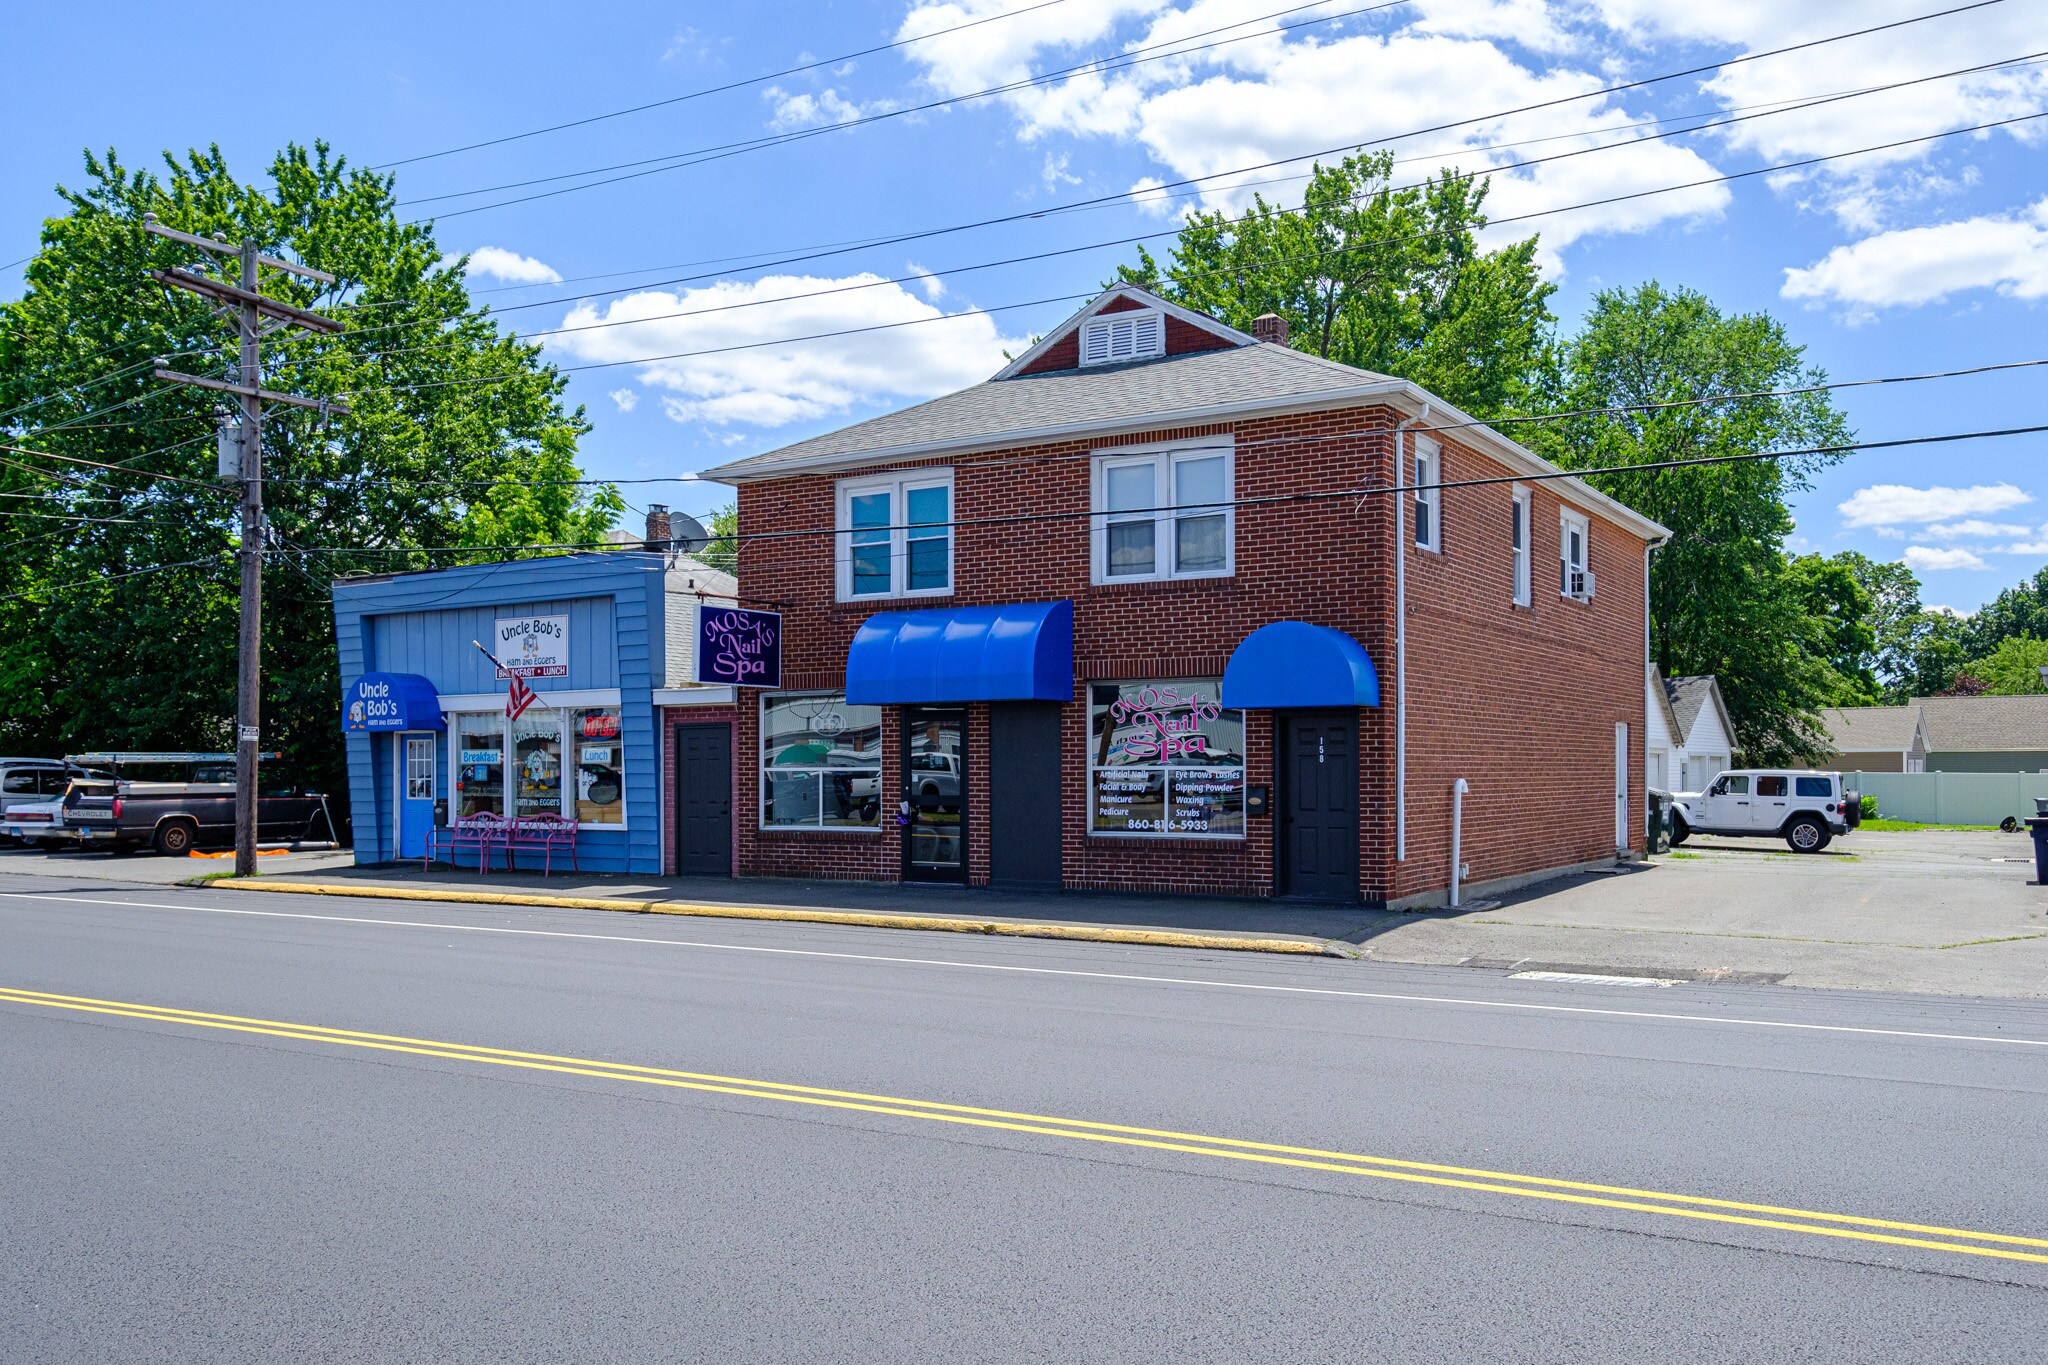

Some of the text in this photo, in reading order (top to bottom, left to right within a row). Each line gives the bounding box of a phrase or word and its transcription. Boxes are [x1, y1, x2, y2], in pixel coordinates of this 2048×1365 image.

[501, 620, 562, 641] Uncle Bob's
[720, 633, 761, 660] Nail
[507, 658, 521, 666] Ham
[714, 653, 765, 682] Spa
[543, 666, 566, 676] LUNCH
[360, 681, 389, 698] Uncle
[367, 699, 398, 716] Bob's
[583, 715, 618, 737] OPEN
[1131, 711, 1200, 738] Nail
[513, 727, 561, 743] Uncle Bob's
[1123, 731, 1206, 763] Spa
[463, 751, 498, 763] Breakfast
[584, 750, 608, 761] Lunch
[1099, 770, 1149, 780] Artificial Nails
[1175, 771, 1240, 780] Eye Brows Lashes
[1099, 783, 1146, 793] Facial & Body
[1175, 782, 1234, 793] Dipping Powder
[1099, 795, 1132, 803] Manicure
[1175, 796, 1204, 806] Waxing
[68, 810, 107, 818] CHEVROLET
[1099, 807, 1129, 816] Pedicure
[1175, 808, 1200, 817] Scrubs
[1127, 819, 1208, 830] 860-816-5933
